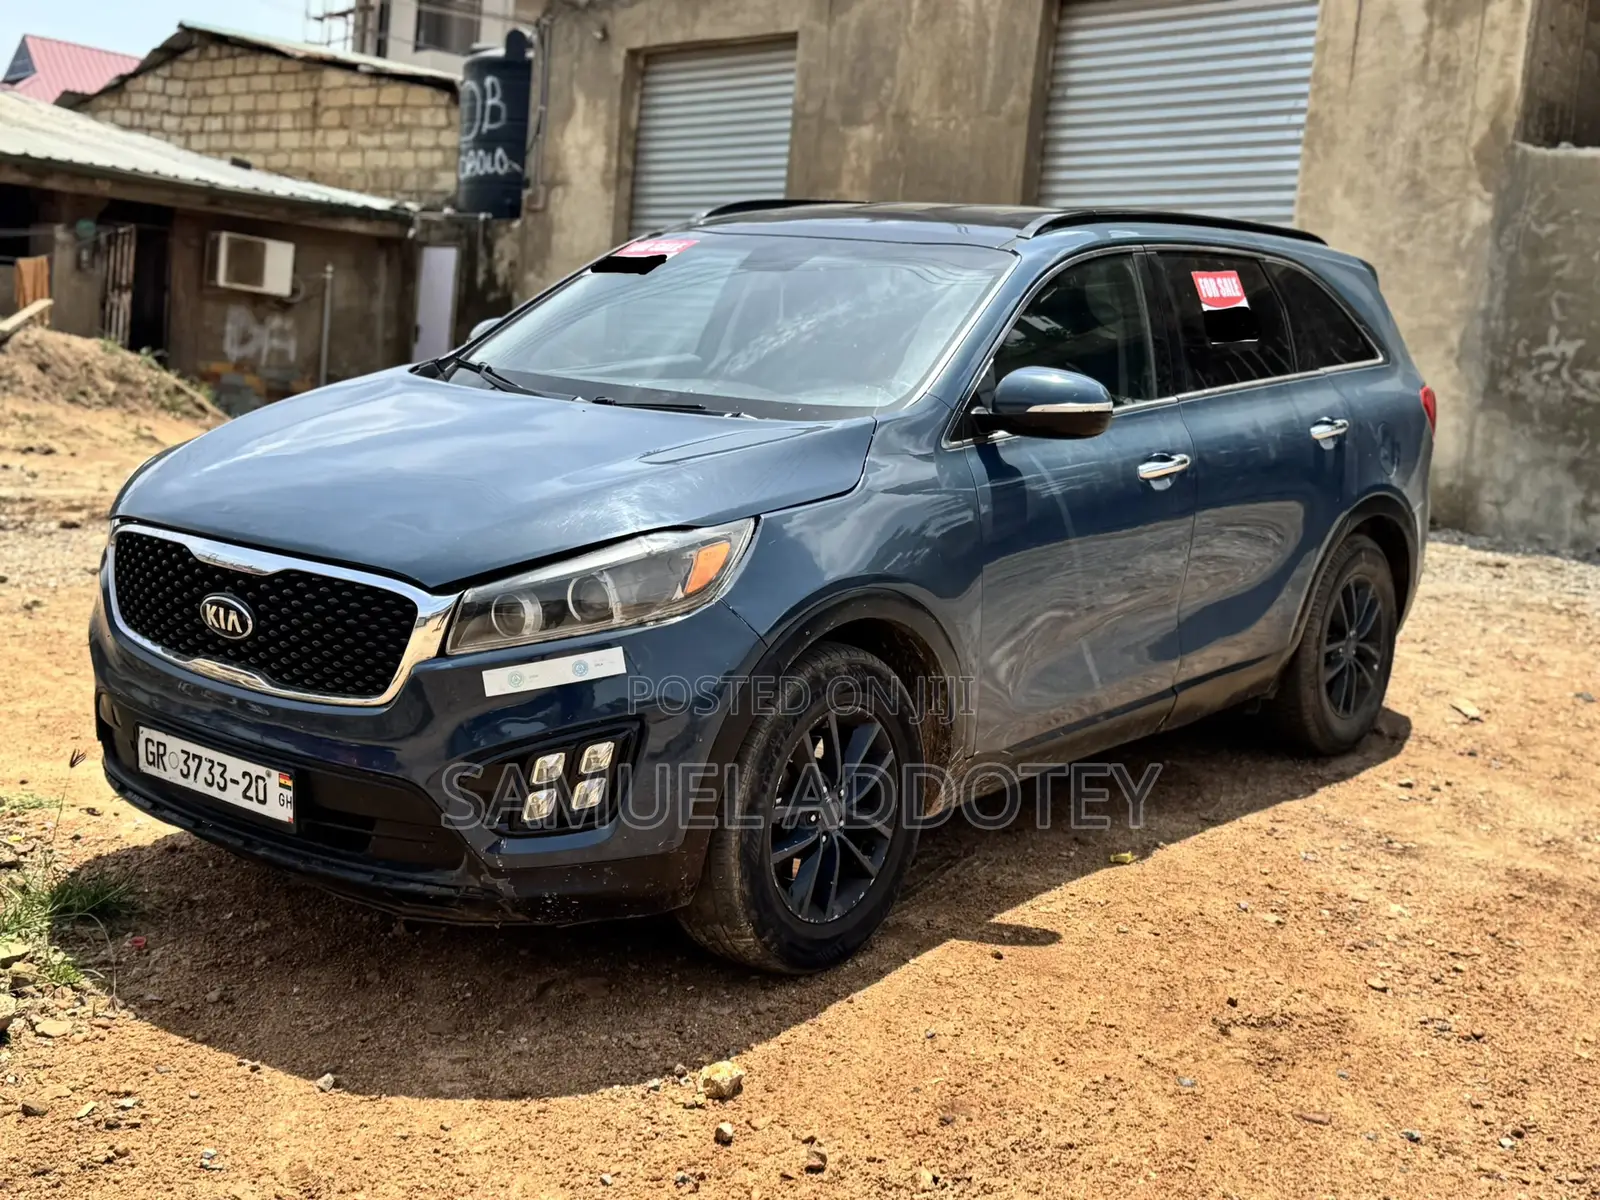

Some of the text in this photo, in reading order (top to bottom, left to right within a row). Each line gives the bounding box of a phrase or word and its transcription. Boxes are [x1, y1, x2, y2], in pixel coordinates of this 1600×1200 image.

[1198, 277, 1242, 298] FOR SALE
[205, 603, 243, 634] KIA
[144, 737, 268, 806] GR 3733-20
[278, 792, 293, 810] GH
